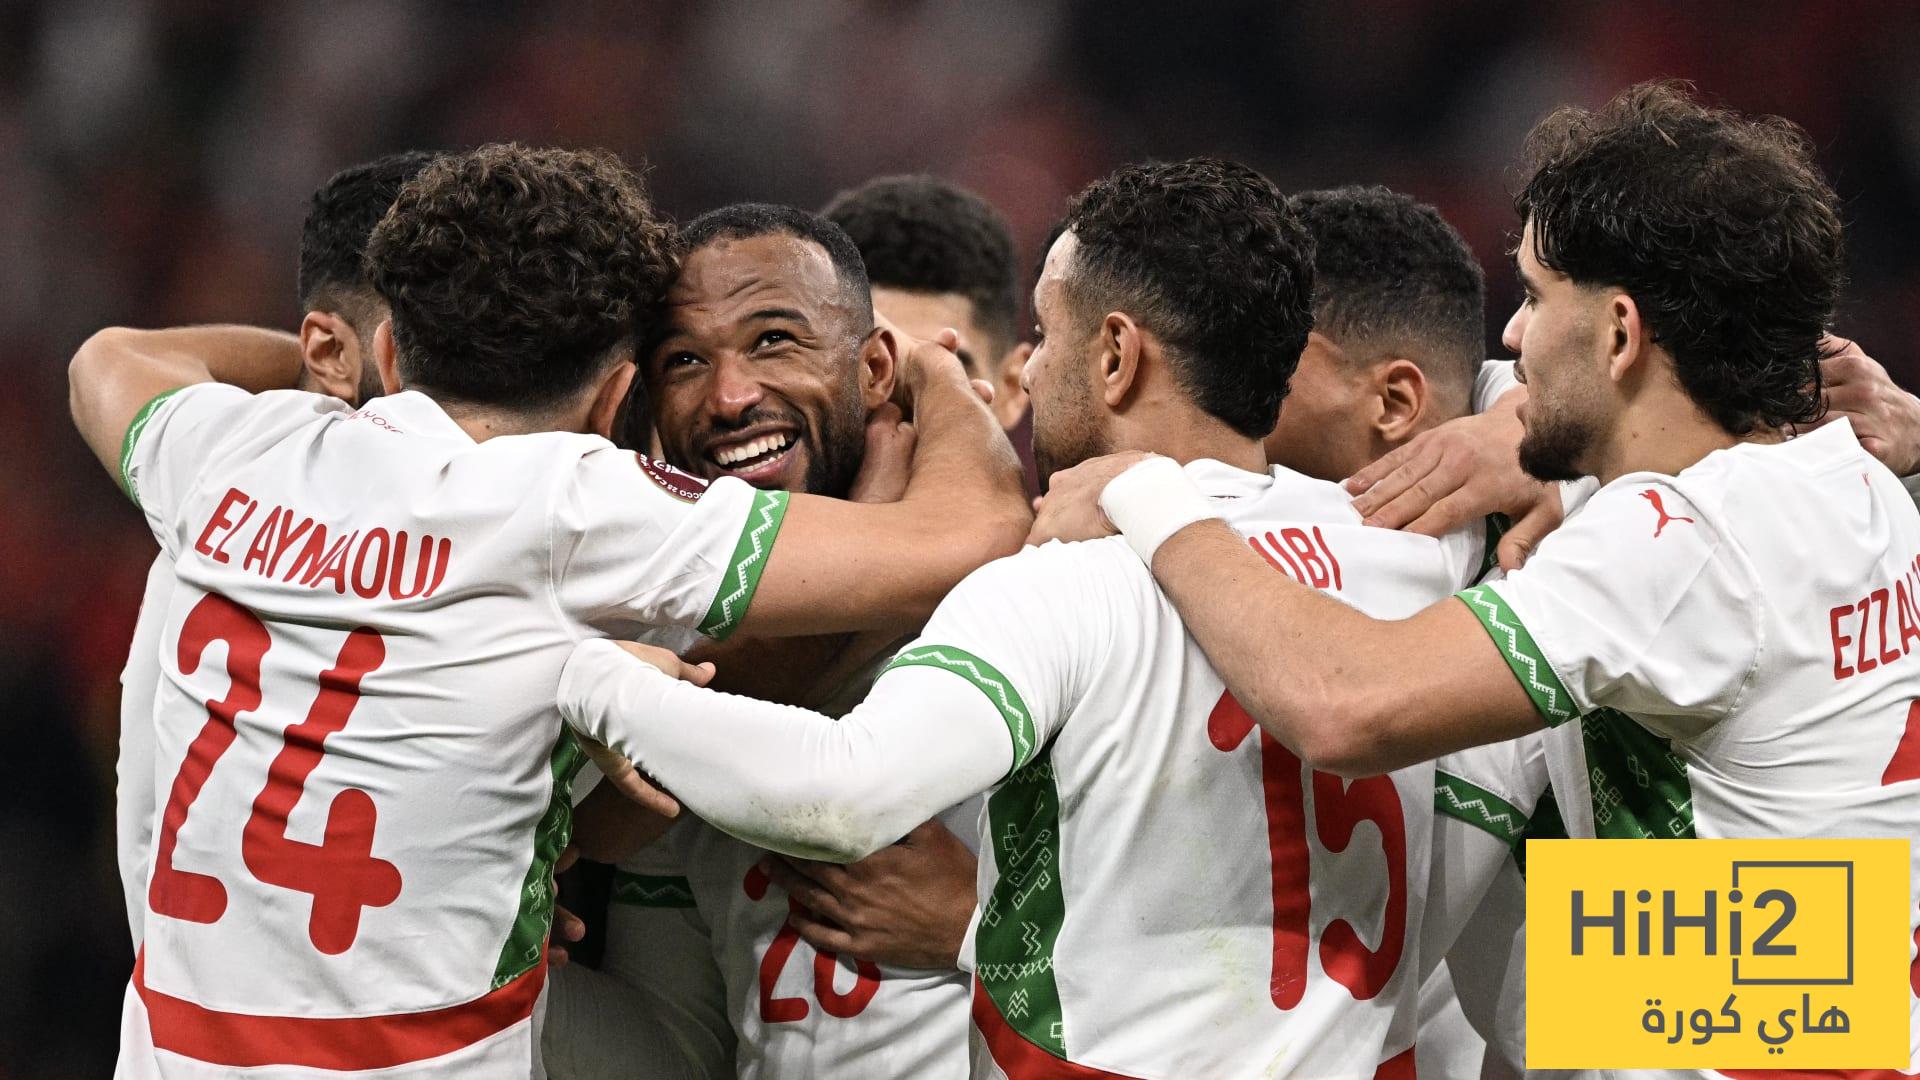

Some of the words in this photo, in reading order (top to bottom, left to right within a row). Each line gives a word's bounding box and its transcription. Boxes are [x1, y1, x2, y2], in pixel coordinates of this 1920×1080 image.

[194, 487, 259, 565] EL
[242, 504, 452, 601] AYNAOUI
[147, 590, 403, 957] 24
[1207, 686, 1408, 1011] 15
